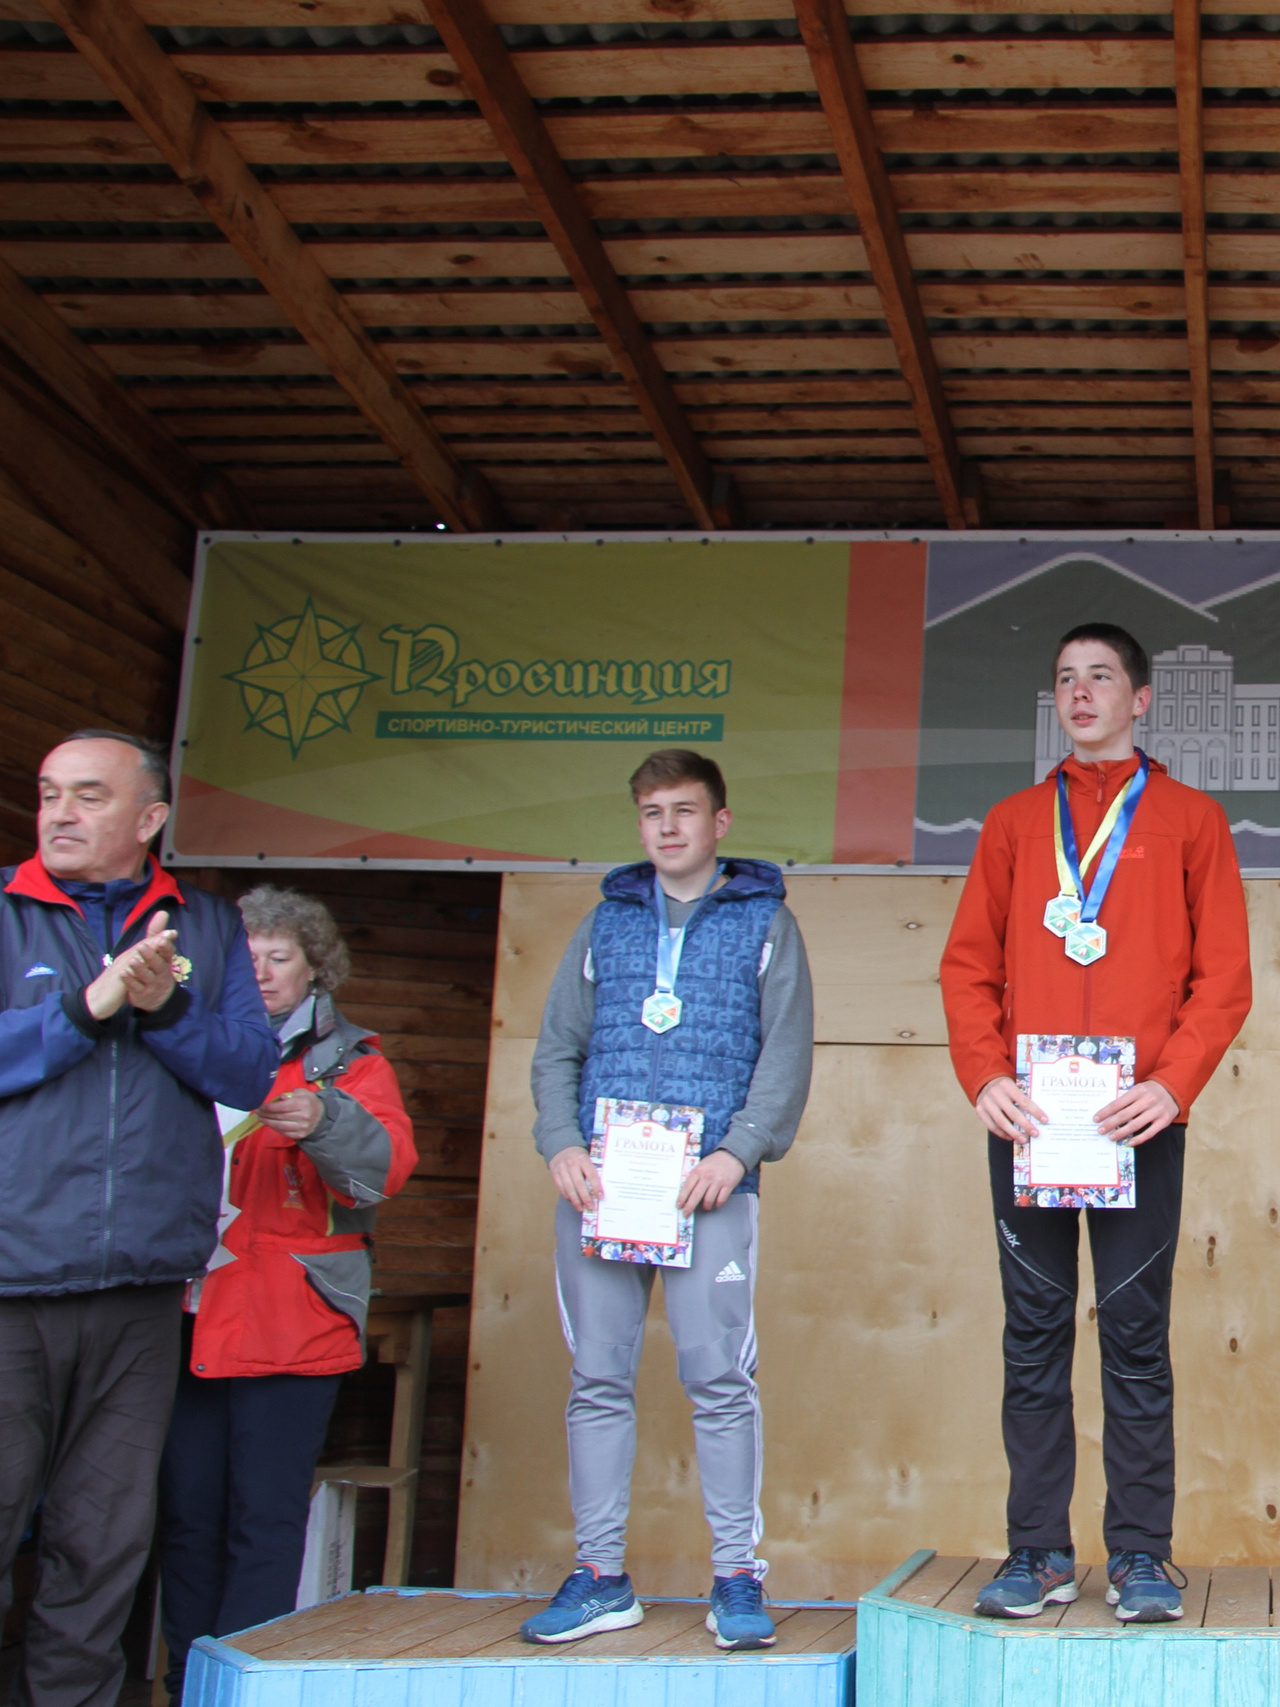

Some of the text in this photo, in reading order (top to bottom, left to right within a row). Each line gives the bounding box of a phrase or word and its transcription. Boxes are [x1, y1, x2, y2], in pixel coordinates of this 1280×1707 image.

[378, 623, 732, 708] Провинция
[387, 717, 712, 737] СПОРТИВНО-ТУРИСТИЧЕСКИЙ ЦЕНТР
[1041, 1075, 1107, 1088] ГРАМОТА
[614, 1137, 676, 1153] ГРАМОТА
[715, 1273, 746, 1283] adidas
